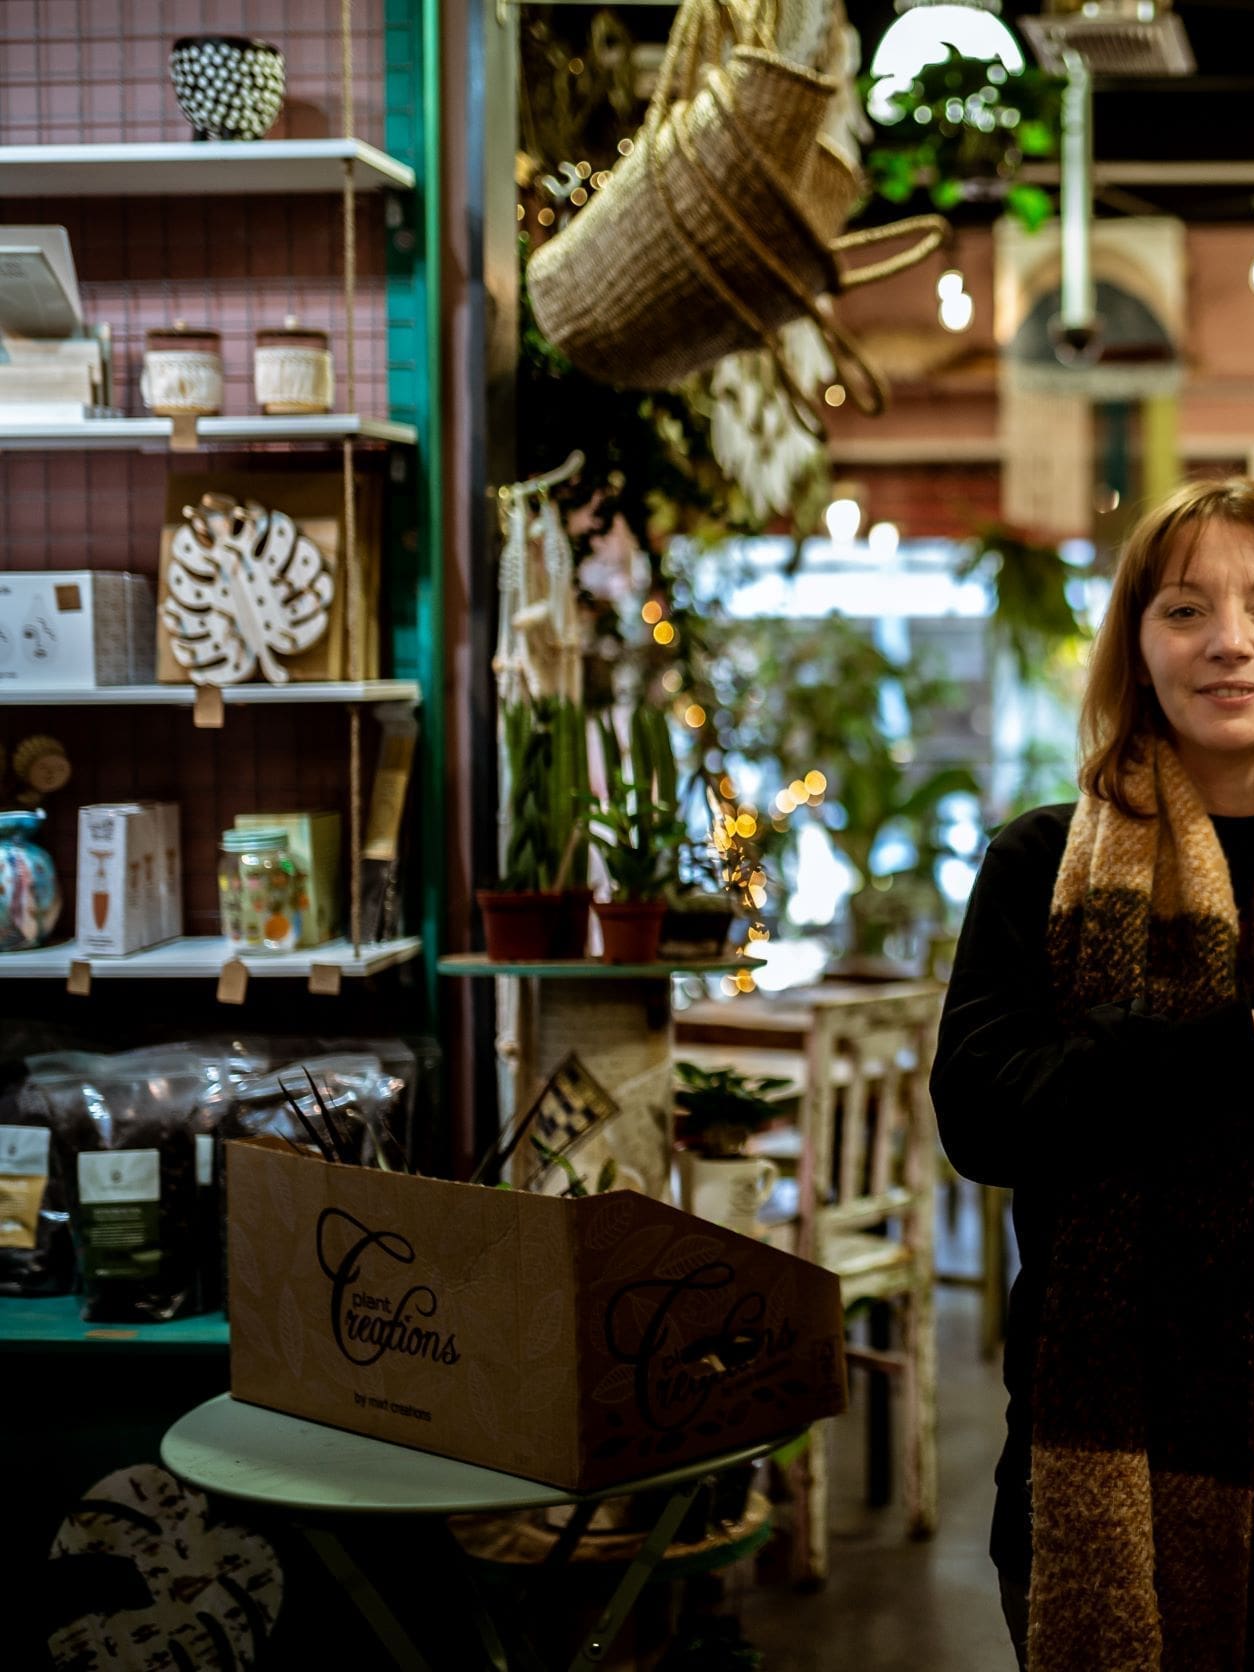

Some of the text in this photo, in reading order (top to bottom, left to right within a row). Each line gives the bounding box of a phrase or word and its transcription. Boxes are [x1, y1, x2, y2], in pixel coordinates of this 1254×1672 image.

[316, 1207, 462, 1367] Creations
[352, 1292, 393, 1314] plant
[353, 1390, 366, 1409] by
[390, 1402, 433, 1423] creations
